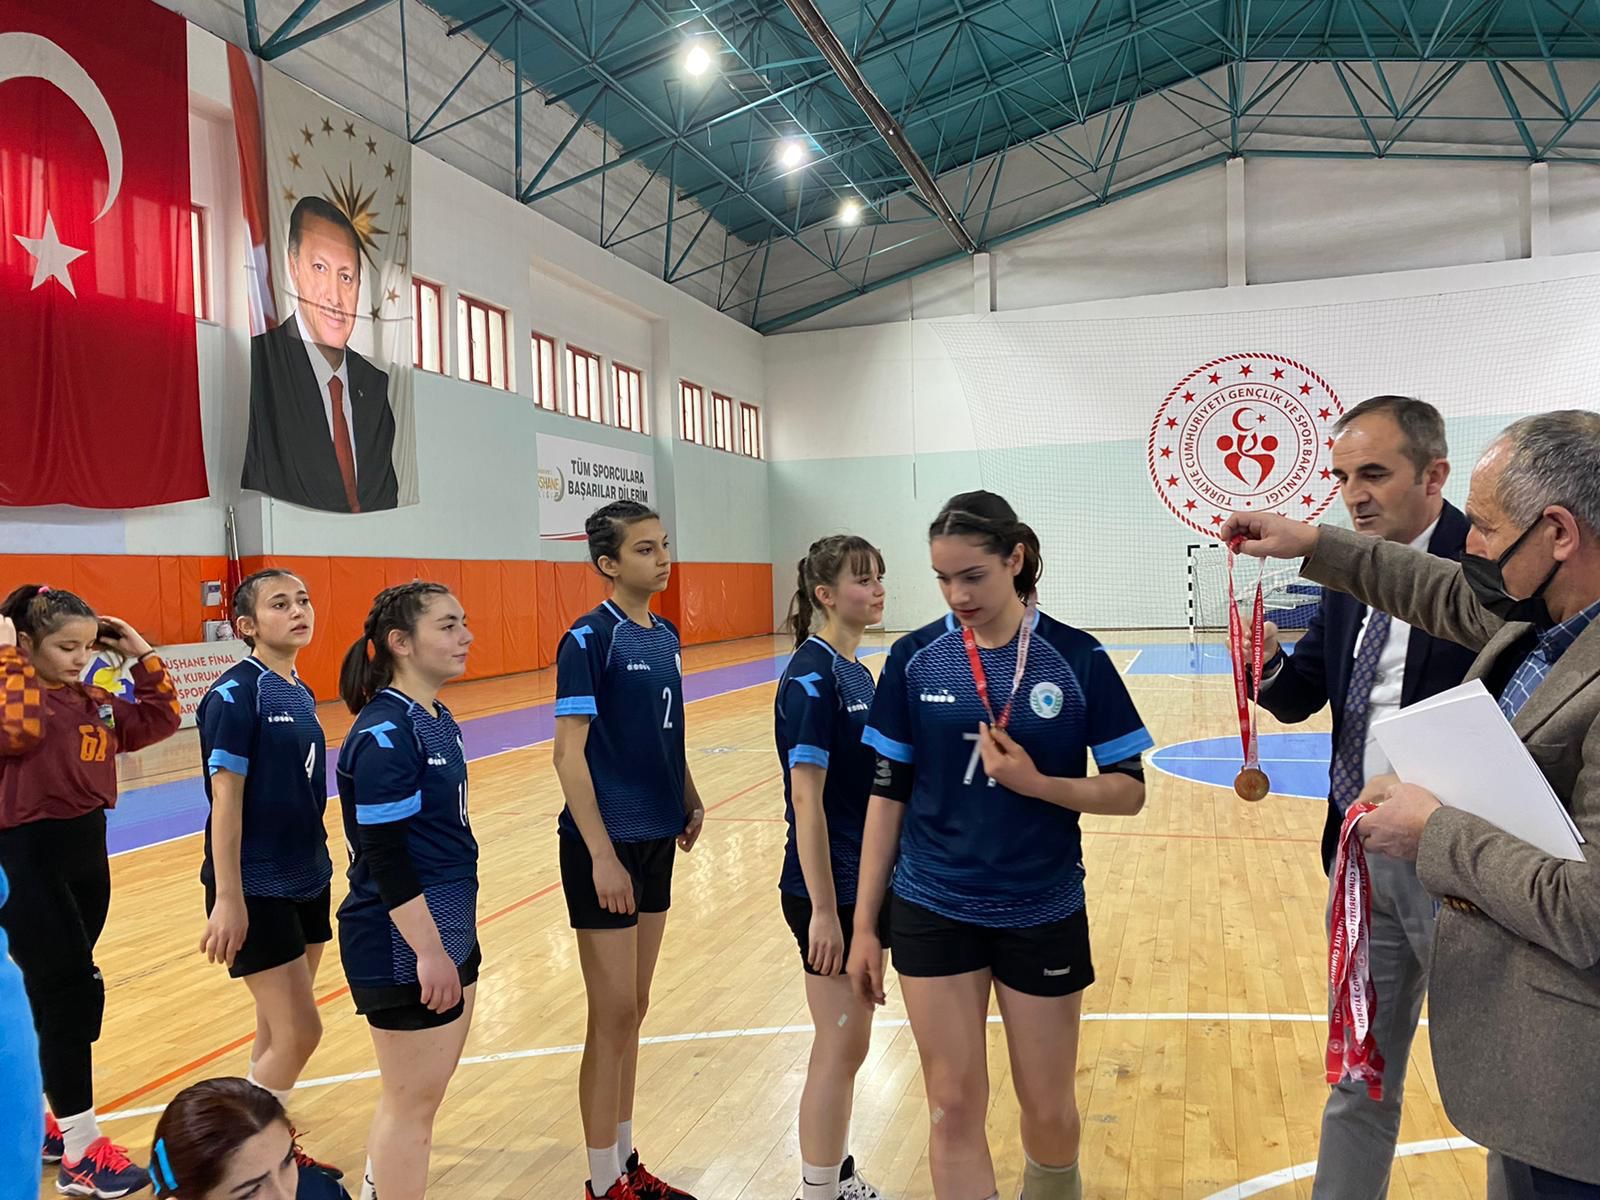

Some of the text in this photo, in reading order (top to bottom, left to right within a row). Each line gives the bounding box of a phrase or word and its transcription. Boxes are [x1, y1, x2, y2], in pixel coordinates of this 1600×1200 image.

[1184, 387, 1313, 506] TÜRKİYE CUMHURİYETİ GENÇLİK VE SPOR BAKANLIĞI
[570, 457, 645, 485] TÜM SPORCULARA
[568, 480, 616, 501] BAŞARILAR
[618, 484, 649, 503] DİLERİM
[165, 653, 237, 672] ÜŞHANE FİNAL
[662, 686, 673, 729] 2
[79, 724, 108, 762] 61
[304, 742, 316, 780] 4
